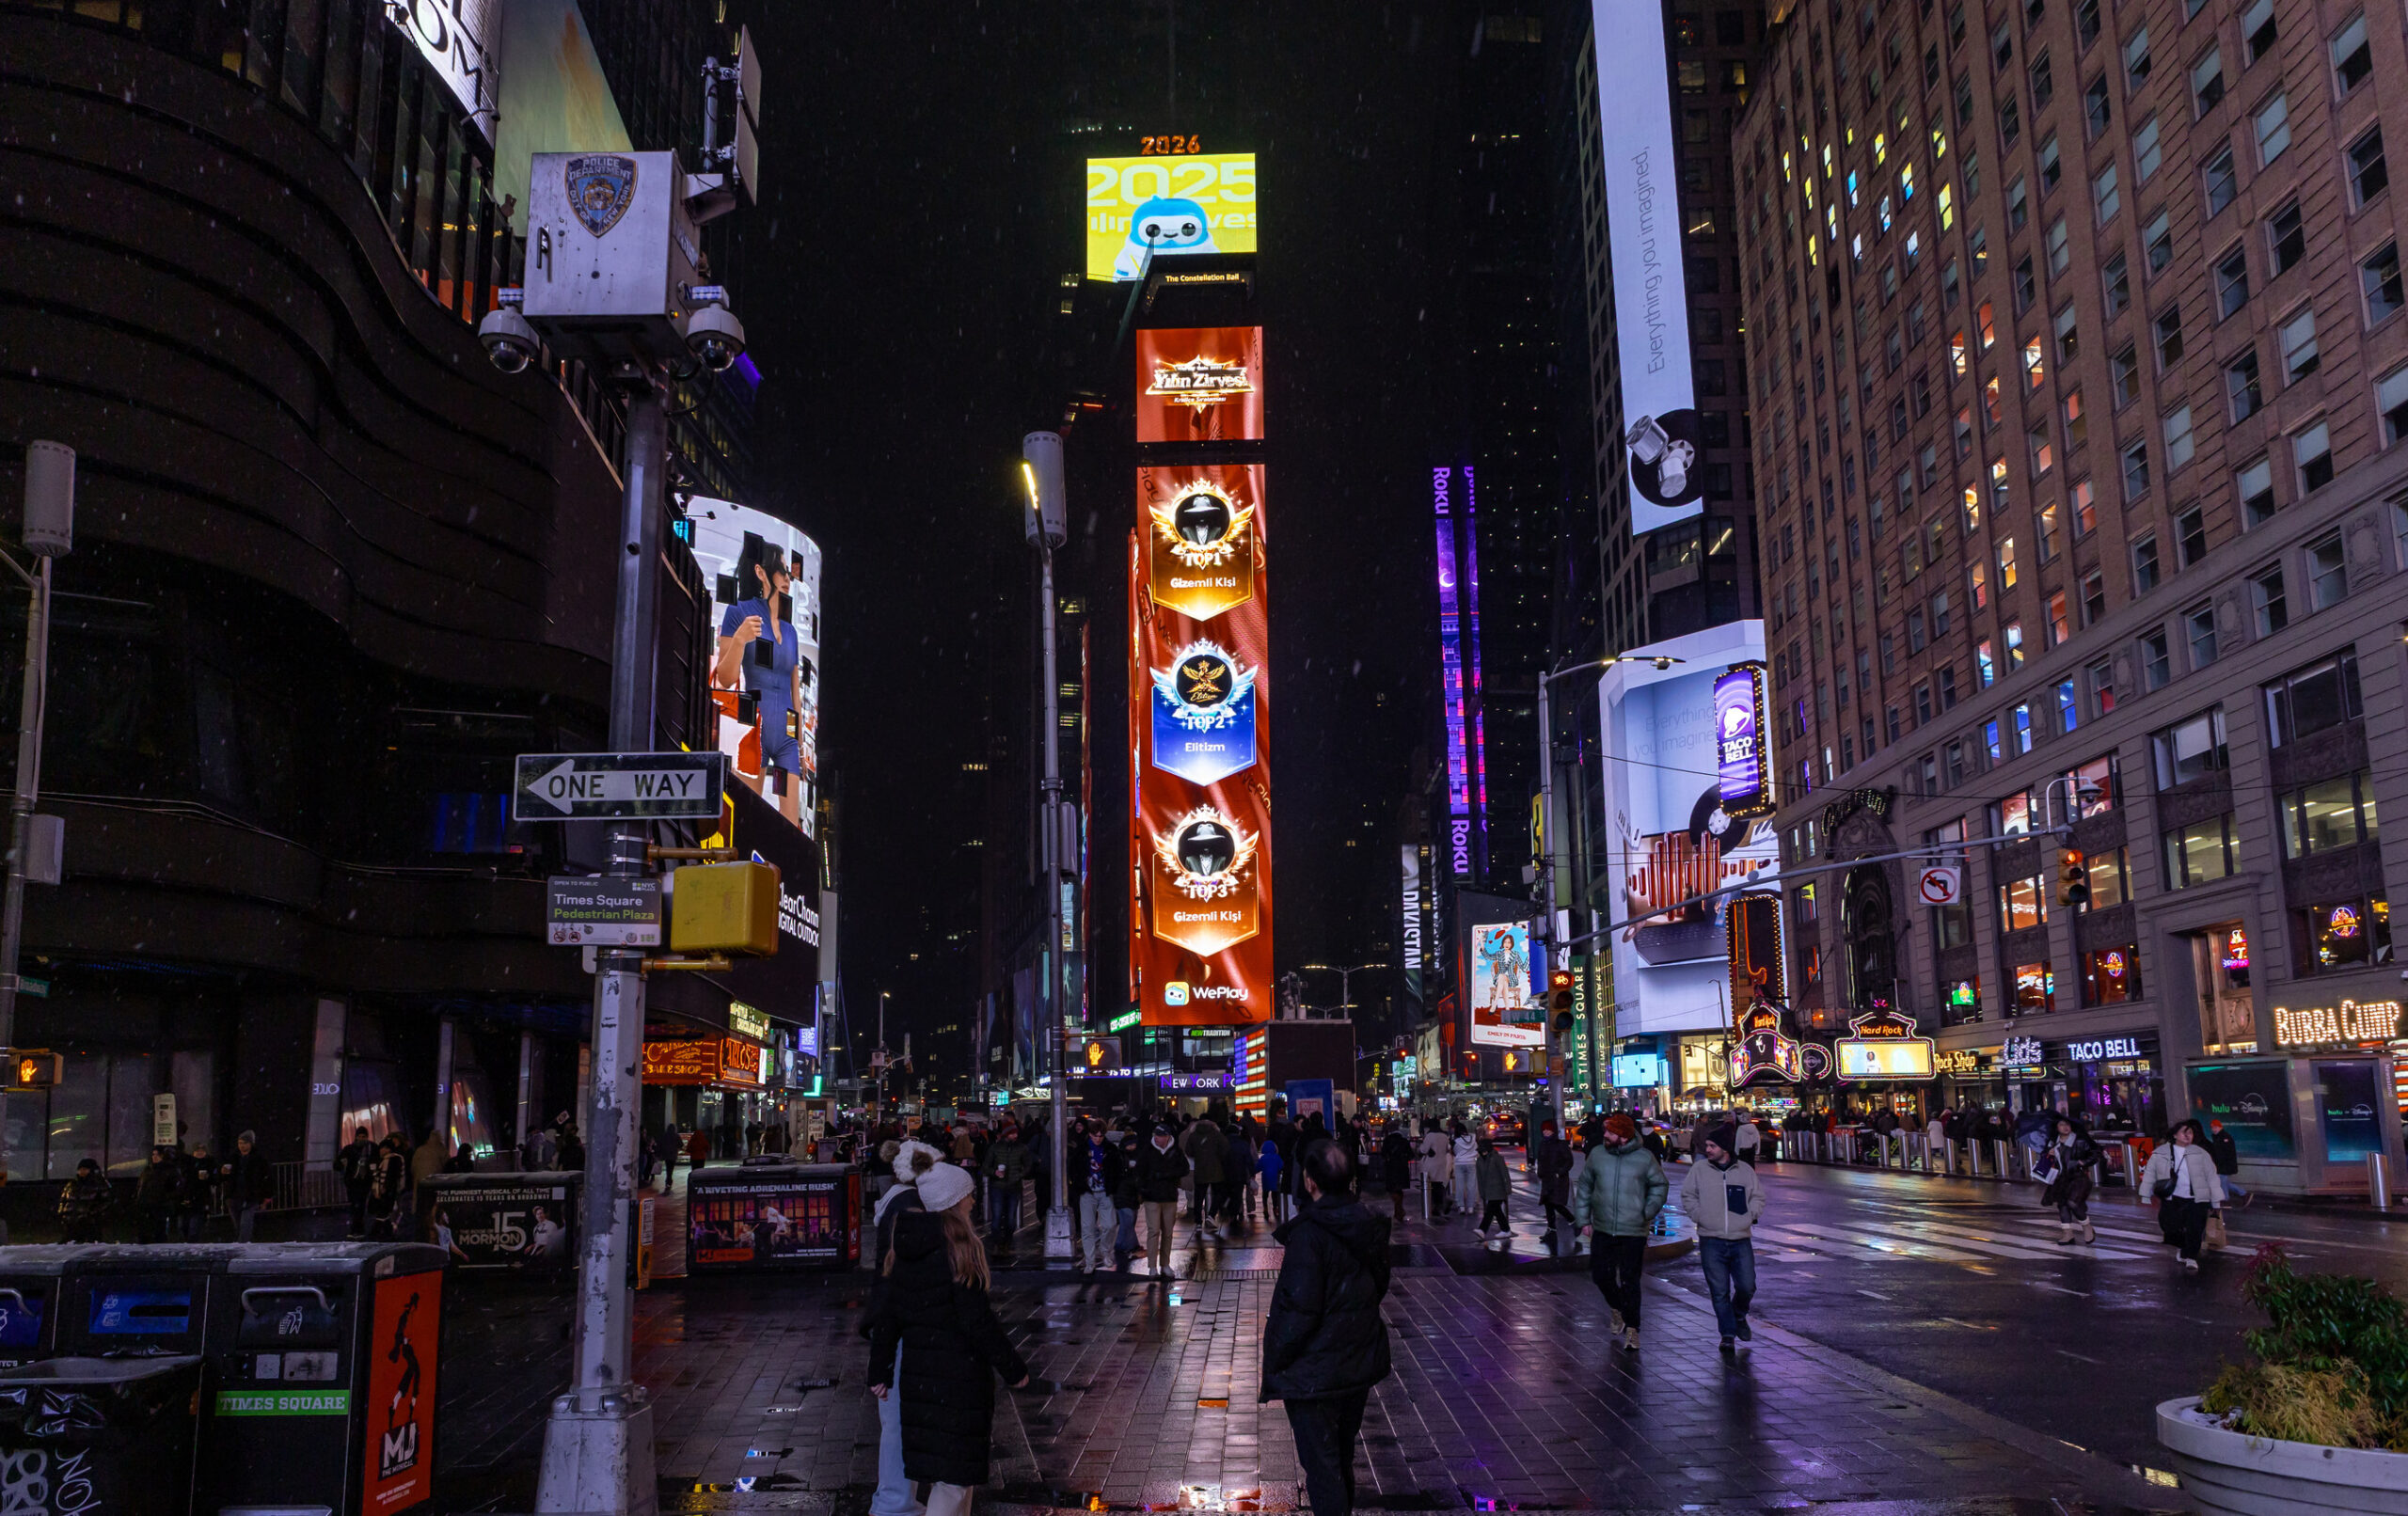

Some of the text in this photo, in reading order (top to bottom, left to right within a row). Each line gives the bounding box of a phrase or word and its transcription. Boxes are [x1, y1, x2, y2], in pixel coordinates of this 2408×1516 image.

[1141, 134, 1201, 155] 2026
[582, 157, 620, 168] POLICE
[568, 166, 632, 181] DEPARTMENT
[1087, 161, 1256, 207] 2025
[603, 209, 618, 228] NEW
[618, 185, 631, 206] YORK
[1631, 146, 1667, 375] Everything you imagined,
[1180, 274, 1225, 282] Constellation
[1184, 552, 1223, 566] TOP1
[1170, 576, 1237, 589] Gizemli Kişi
[1185, 715, 1226, 730] TOP2
[1646, 705, 1715, 732] Everything
[1184, 742, 1226, 753] Elitizm
[1634, 740, 1657, 761] you
[1722, 735, 1753, 752] TACO
[1725, 749, 1754, 764] BELL
[548, 773, 695, 798] ONE WAY
[1187, 884, 1228, 899] TOP3
[554, 893, 643, 908] Times Square
[554, 908, 655, 920] Pedestrian Plaza
[1173, 910, 1242, 924] Gizemli Kişi
[1192, 986, 1249, 1002] WePlay
[1574, 966, 1586, 1020] SQUARE
[1512, 1011, 1536, 1022] W 44
[2274, 999, 2400, 1045] BUBBA GUMP
[1860, 1025, 1903, 1036] Hard Rock
[1577, 1034, 1587, 1075] TIMES
[2003, 1035, 2043, 1066] Lids
[2067, 1037, 2141, 1061] TACO BELL
[1934, 1050, 1976, 1073] Rock Shop
[646, 1064, 702, 1075] BAKE SHOP
[1161, 1075, 1187, 1088] NEW
[1189, 1075, 1220, 1088] YORK
[2211, 1103, 2231, 1114] hulu
[705, 1186, 749, 1194] RIVETING
[750, 1184, 808, 1193] ADRENALINE
[490, 1210, 527, 1252] 15
[458, 1233, 521, 1245] MORMON
[220, 1396, 346, 1411] TIMES SQUARE
[383, 1421, 418, 1469] MJ
[382, 1460, 414, 1477] THE MUSICAL
